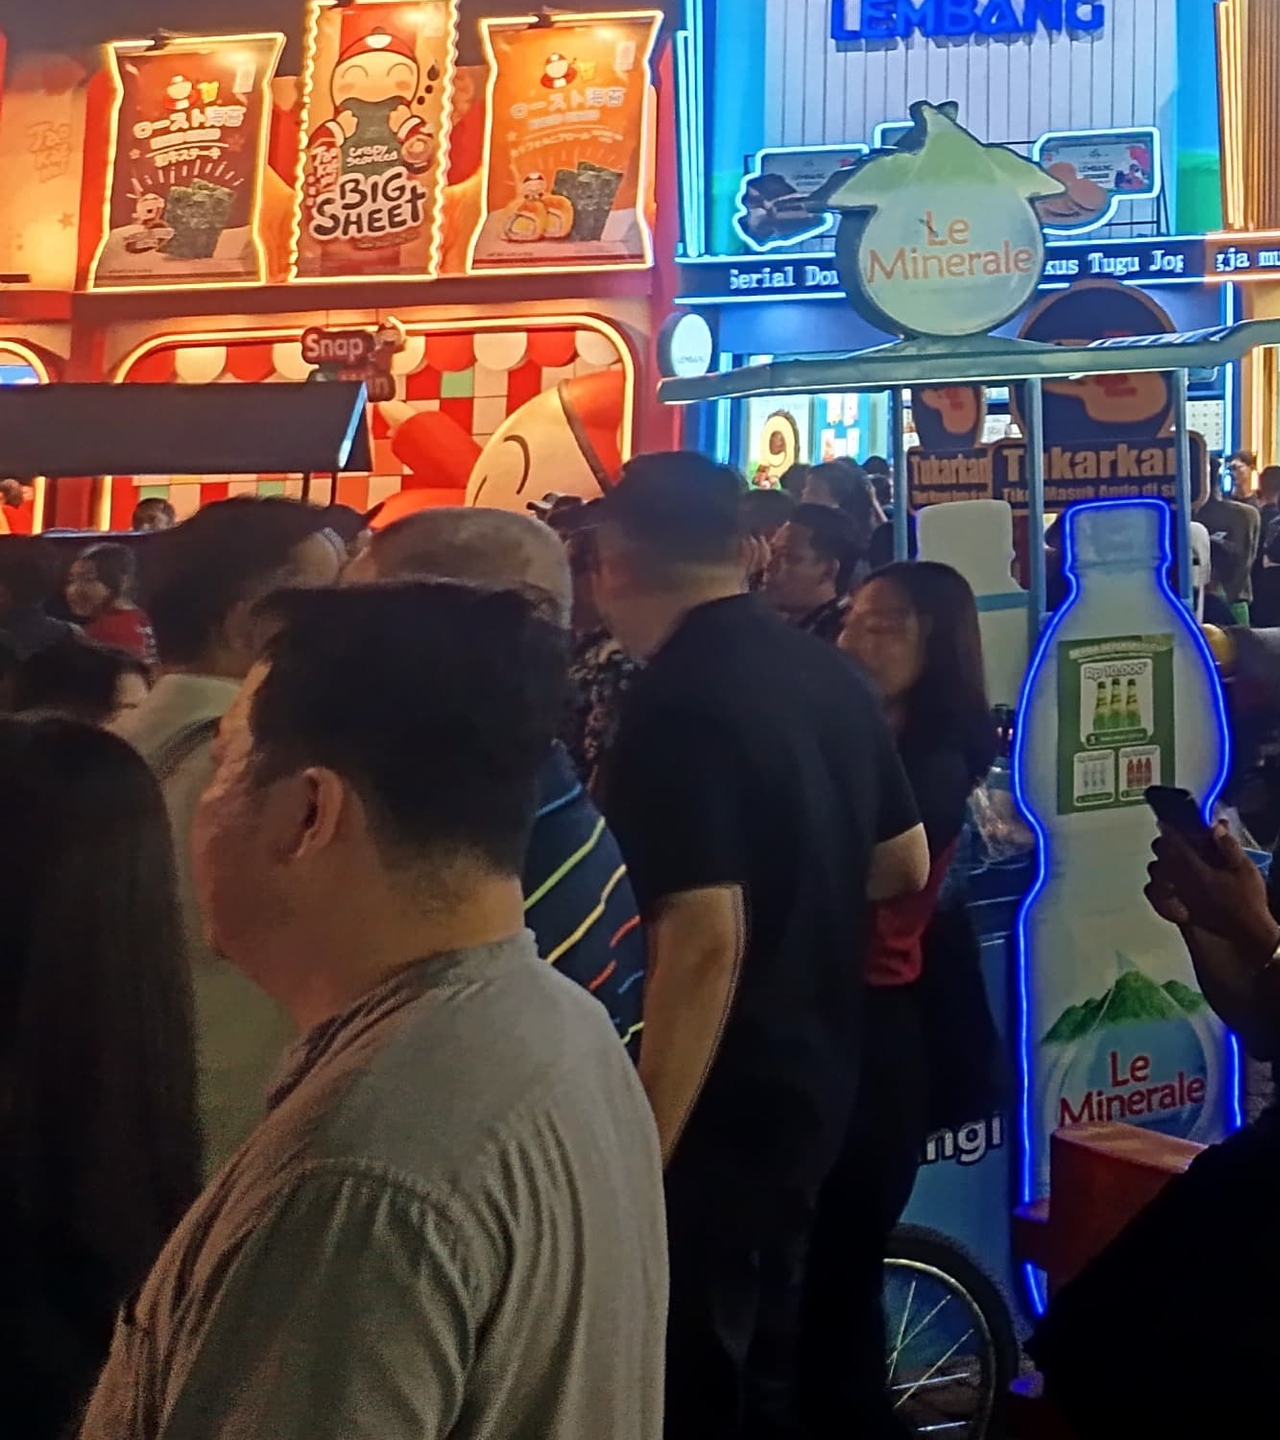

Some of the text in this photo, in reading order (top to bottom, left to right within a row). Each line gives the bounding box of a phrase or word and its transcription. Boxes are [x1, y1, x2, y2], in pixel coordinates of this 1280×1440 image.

[340, 171, 406, 211] BIG
[926, 211, 970, 248] Le
[868, 240, 1033, 285] Minerale
[1088, 252, 1140, 276] Tugu
[306, 333, 364, 363] Snap
[1110, 1050, 1151, 1087] Le
[1059, 1071, 1206, 1127] Minerale
